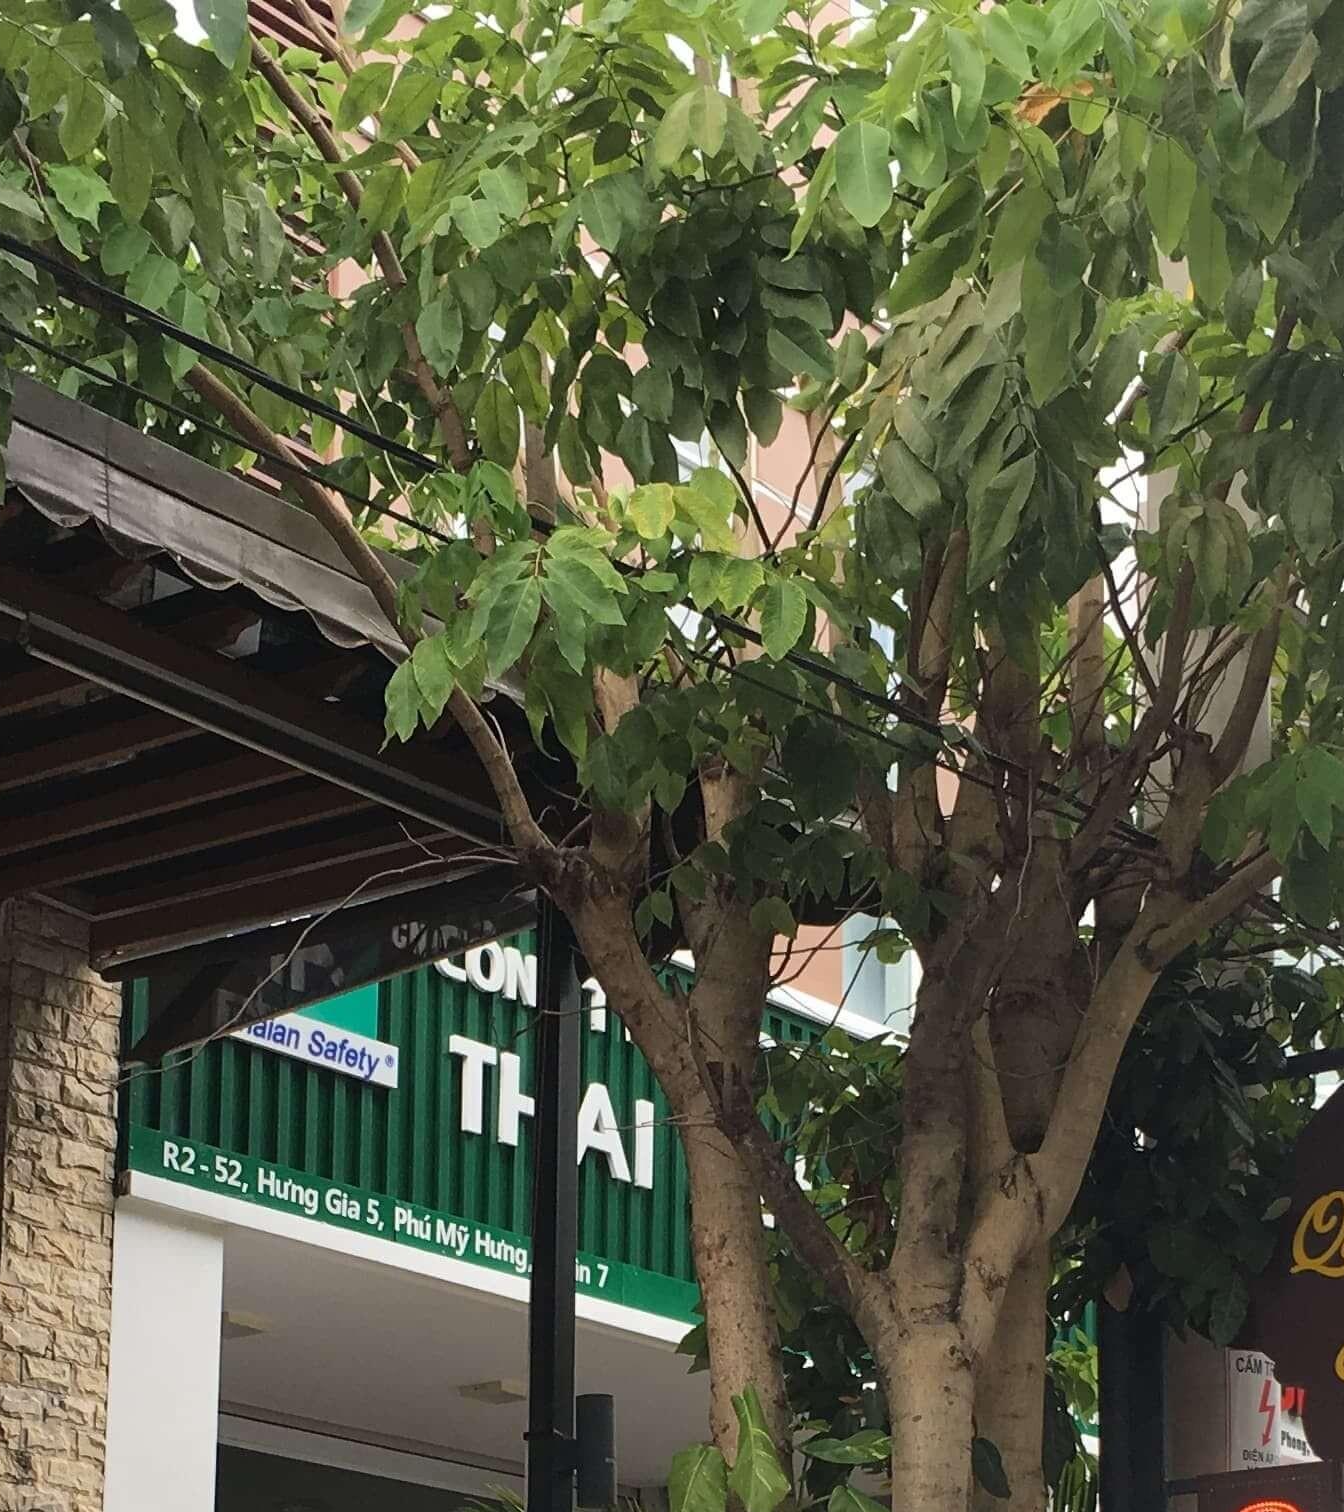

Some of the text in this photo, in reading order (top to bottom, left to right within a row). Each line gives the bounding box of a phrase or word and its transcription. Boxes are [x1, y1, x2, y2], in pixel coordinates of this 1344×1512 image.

[308, 1030, 379, 1081] Safety
[257, 1167, 320, 1216] Hưng
[324, 1188, 361, 1222] Gia
[365, 1200, 386, 1232] 5,
[394, 1205, 431, 1243] Phú
[436, 1217, 470, 1257] Mỹ
[597, 1264, 609, 1289] 7
